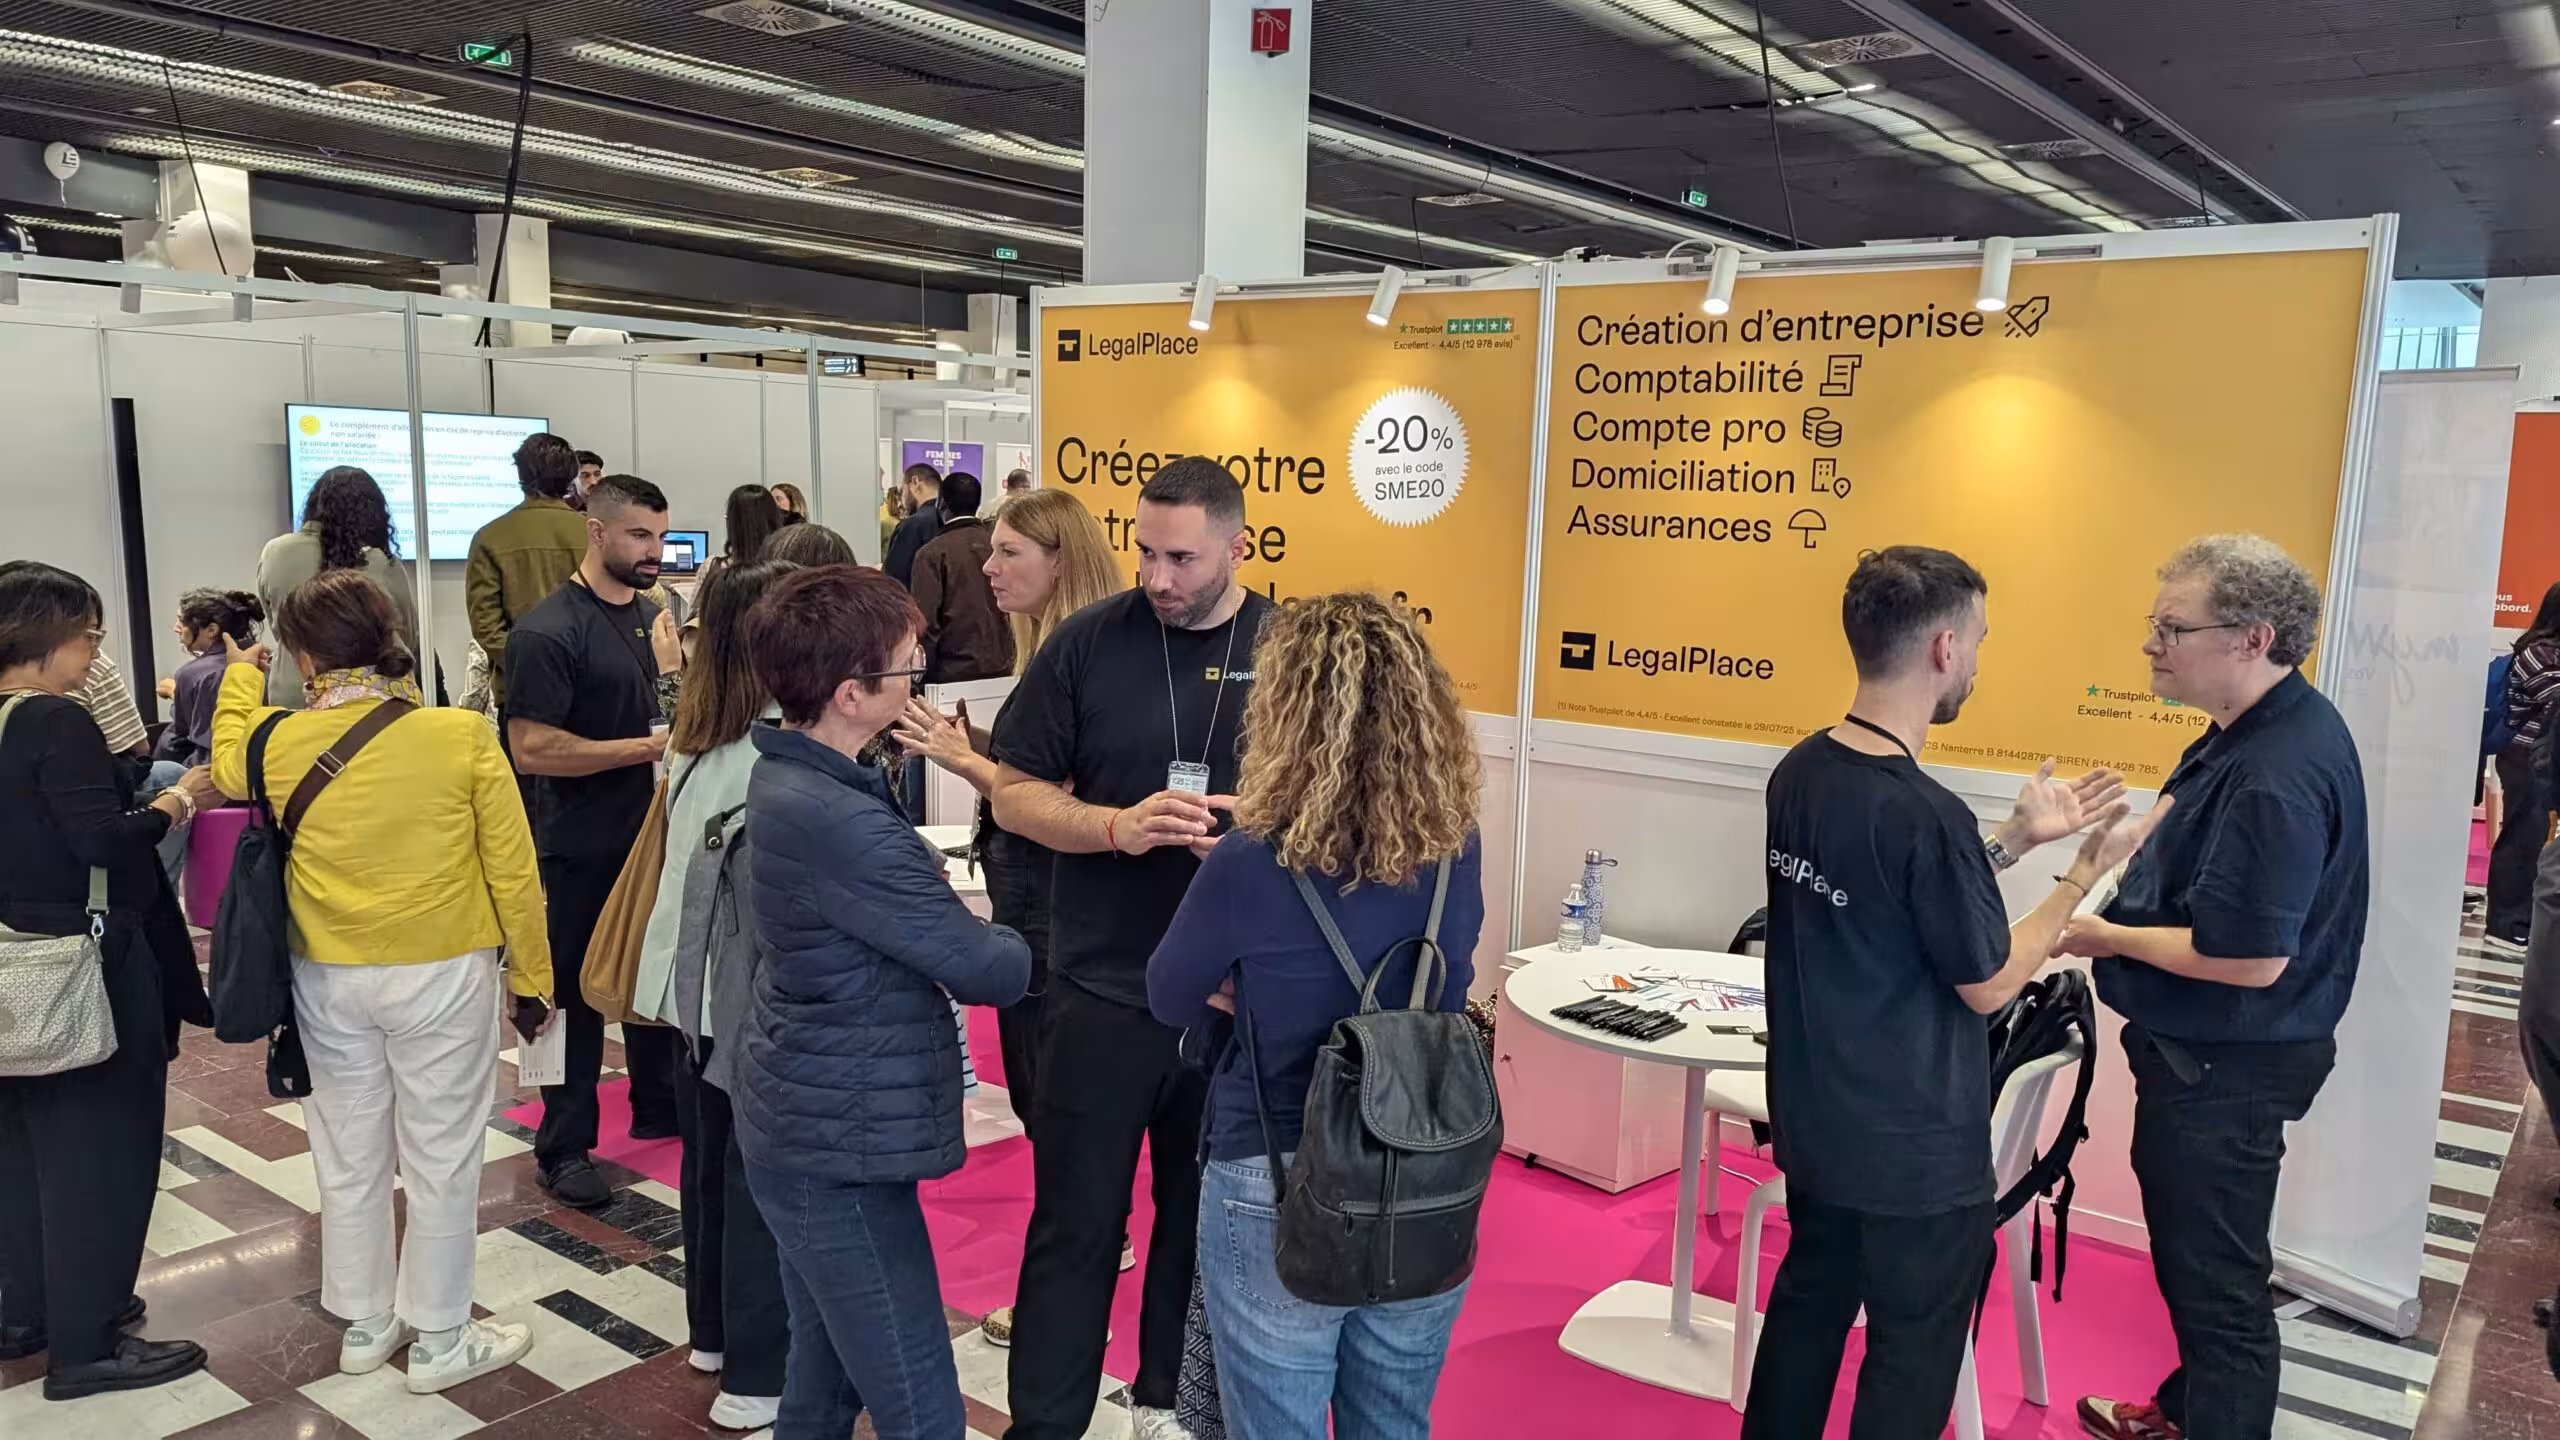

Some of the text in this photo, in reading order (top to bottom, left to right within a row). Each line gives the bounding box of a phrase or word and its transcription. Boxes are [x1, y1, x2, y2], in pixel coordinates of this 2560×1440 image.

[1409, 325, 1443, 335] Trustpilot
[1578, 304, 1983, 347] Création d’entreprise
[1089, 333, 1198, 361] LegalPlace
[1393, 340, 1429, 350] Excellent
[1439, 340, 1461, 349] 4,4/5
[1462, 340, 1474, 349] (12
[1494, 339, 1513, 349] avis)
[1576, 361, 1803, 401] Comptabilité
[1574, 411, 1785, 450] Compte pro
[925, 450, 962, 460] FEMES
[1057, 437, 1325, 495] Crée otre
[1375, 460, 1444, 476] avec le code
[1375, 478, 1445, 501] SME20
[1572, 459, 1794, 493] Domiciliation
[1567, 505, 1771, 542] Assurances
[1608, 641, 1773, 679] LegalPlace
[1223, 670, 1259, 682] LegalP
[2103, 688, 2156, 703] Trustpilot
[1558, 700, 1567, 711] (1)
[1569, 702, 1586, 712] Note
[1589, 705, 1624, 717] Trustpilot
[1625, 709, 1636, 718] de
[1636, 710, 1658, 720] 4,4/5
[1664, 713, 1701, 726] Excellent
[1702, 718, 1743, 729] constatée
[1744, 720, 1752, 730] le
[1753, 722, 1795, 735] 29/07/25
[2077, 704, 2133, 720] Excellent
[2149, 711, 2184, 724] 4,4/5
[2187, 715, 2207, 727] (12
[1923, 741, 1939, 750] CS
[1940, 742, 1984, 756] Nanterre
[1986, 747, 1994, 756] B
[2056, 754, 2090, 767] SIREN
[2092, 758, 2111, 769] 814
[2113, 761, 2135, 772] 428
[2138, 763, 2161, 775] 785.
